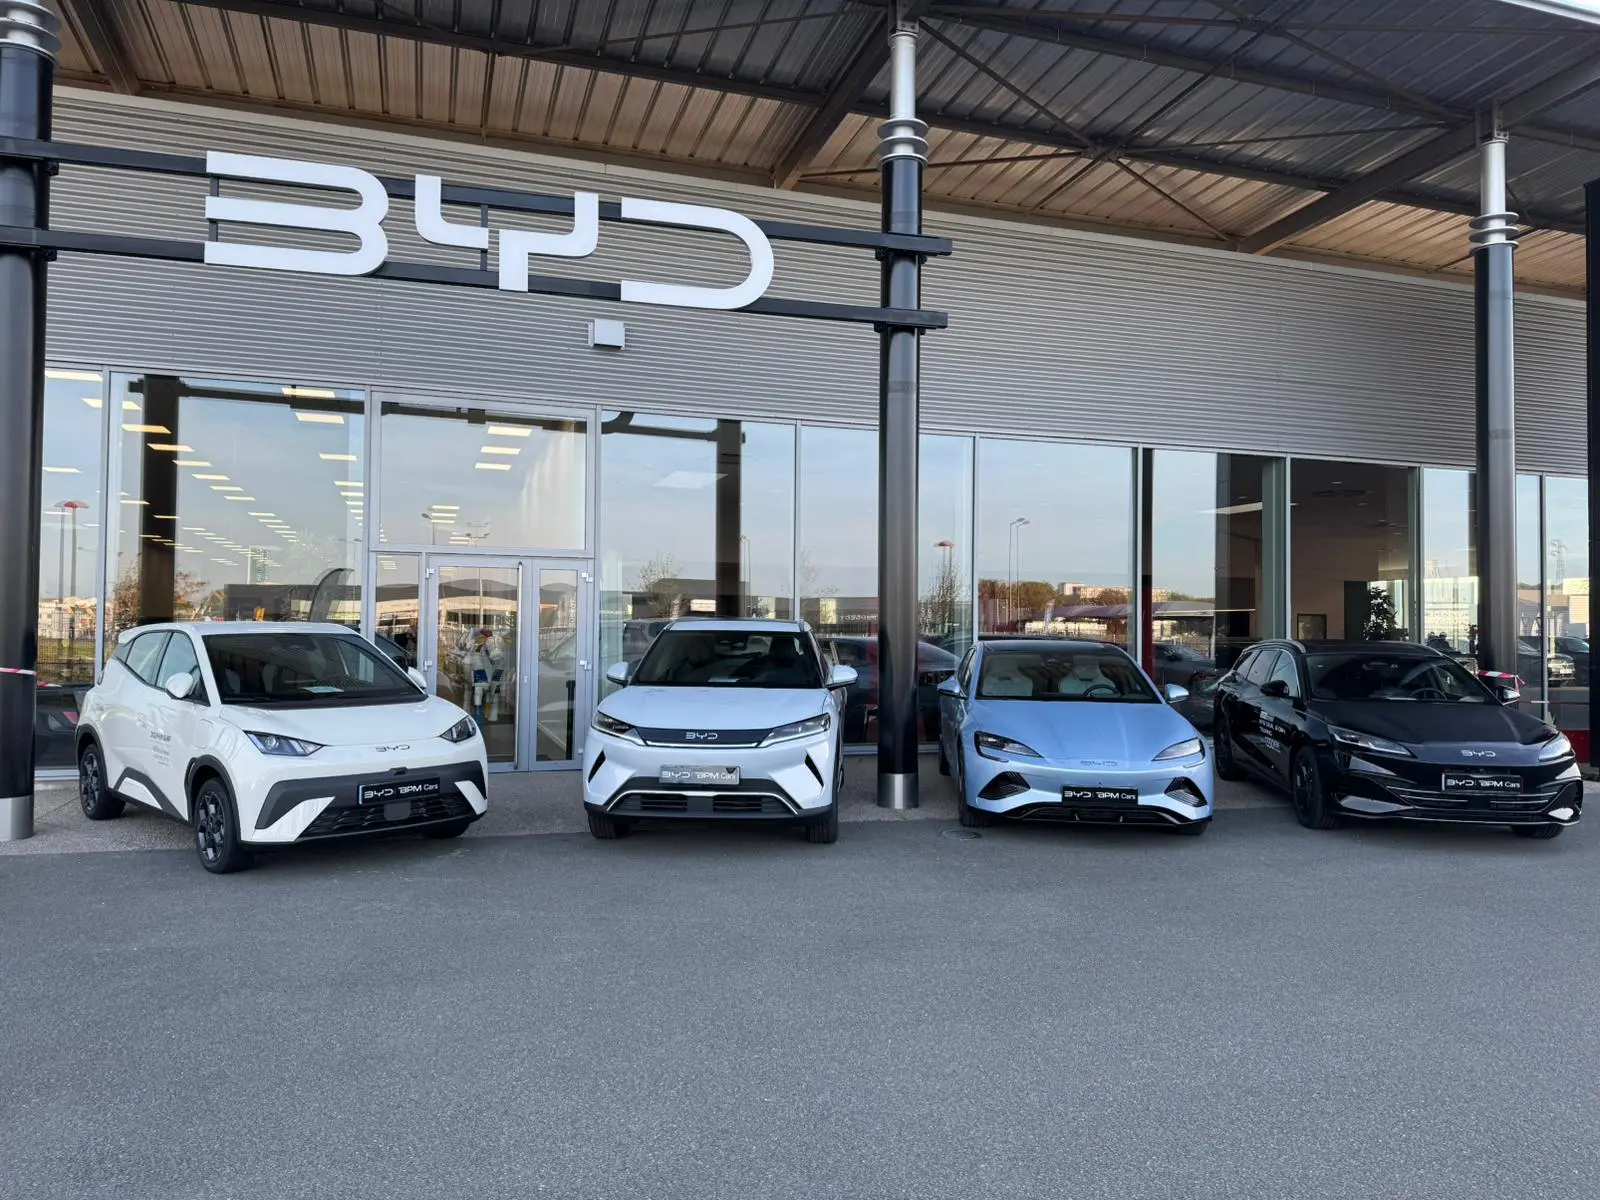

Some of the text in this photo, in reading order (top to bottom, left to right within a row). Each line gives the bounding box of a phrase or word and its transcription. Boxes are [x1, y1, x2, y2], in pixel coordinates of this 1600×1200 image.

[204, 150, 775, 310] BYD
[685, 731, 719, 740] BYD
[375, 744, 410, 753] BYD
[1460, 749, 1497, 758] BYD
[1080, 760, 1118, 768] BYD
[661, 770, 692, 779] BYD
[1446, 778, 1475, 787] BYD
[1504, 780, 1521, 789] Cars
[363, 788, 394, 800] BYD
[423, 782, 439, 792] Cars
[1063, 790, 1092, 798] BYD
[1120, 792, 1137, 800] Cars
